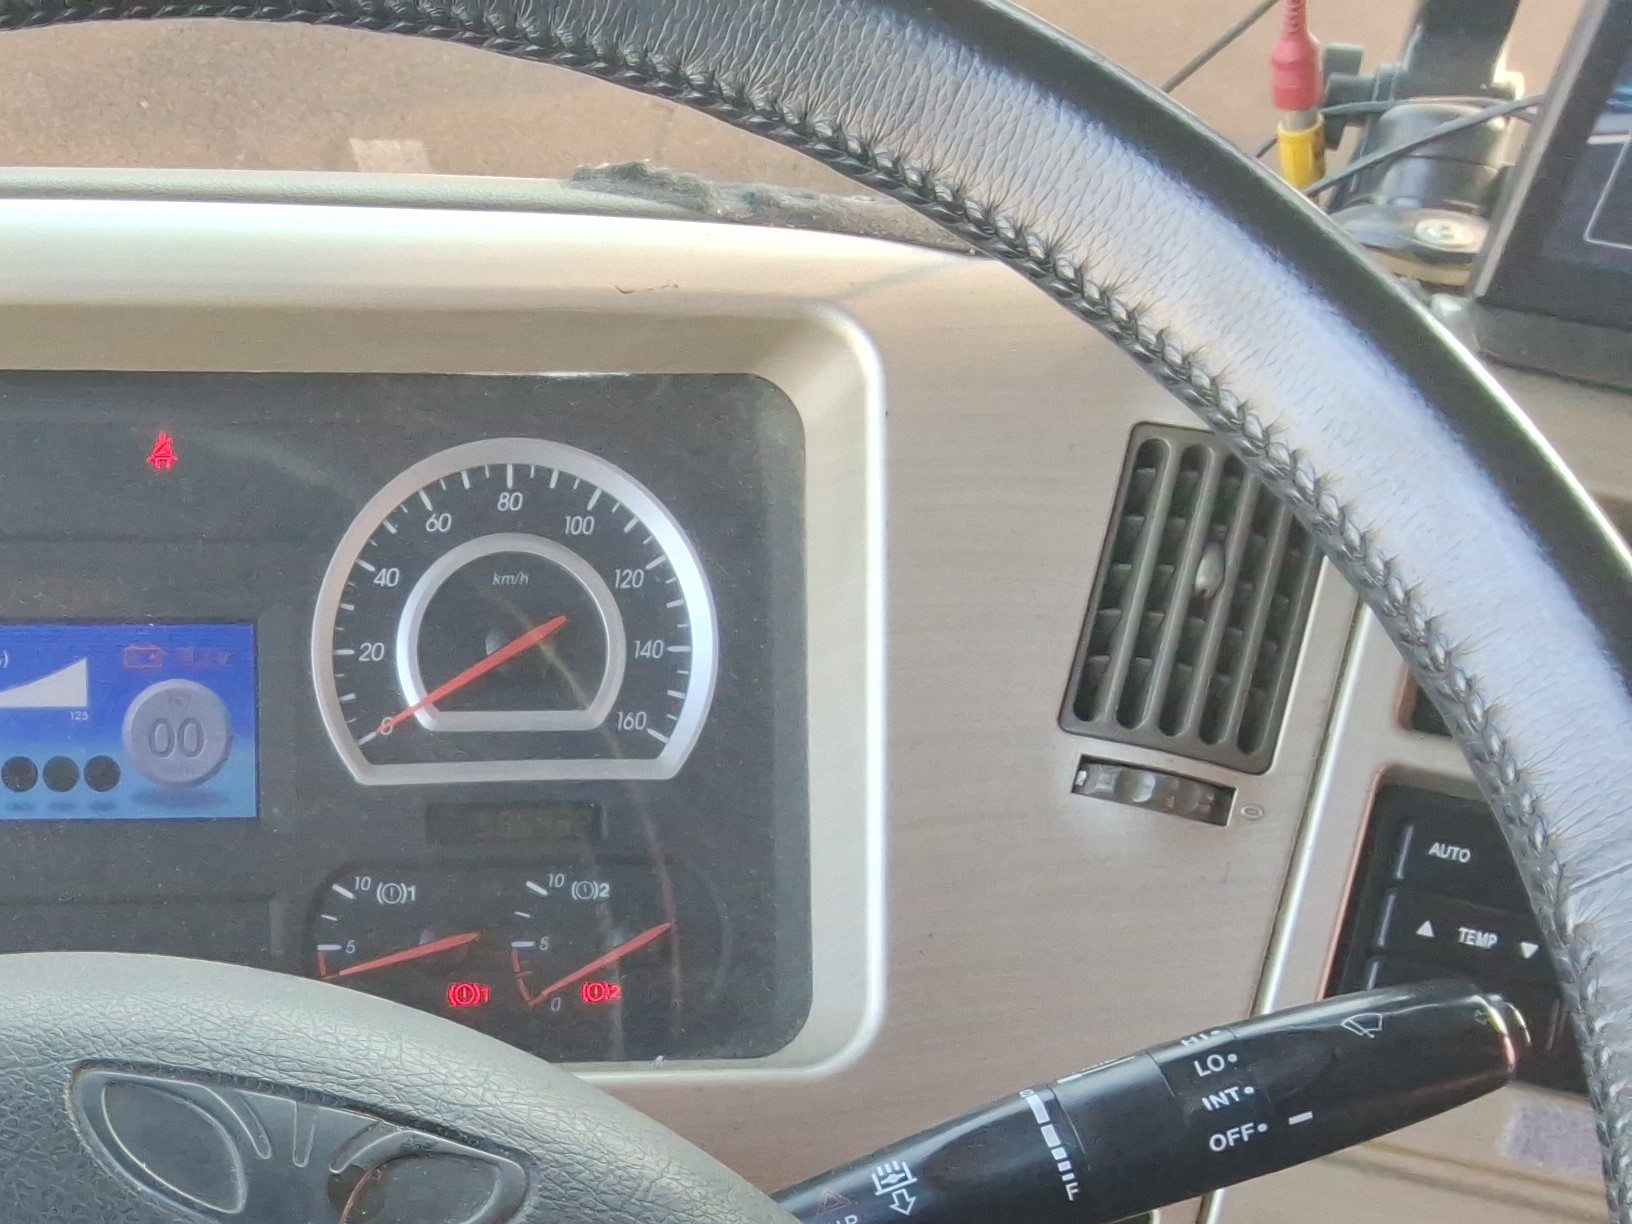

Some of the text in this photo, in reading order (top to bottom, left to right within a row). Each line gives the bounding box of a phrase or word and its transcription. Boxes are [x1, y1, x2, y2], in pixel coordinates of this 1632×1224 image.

[497, 492, 523, 512] 80
[425, 513, 452, 533] 60
[564, 515, 595, 536] 100
[374, 567, 400, 588] 40
[492, 571, 529, 587] km/h
[614, 568, 645, 589] 120
[358, 642, 385, 662] 20
[633, 639, 665, 659] 140
[379, 716, 394, 736] 0
[616, 711, 647, 731] 160
[149, 717, 205, 759] 00
[1428, 842, 1471, 864] AUTO
[354, 876, 372, 892] 10
[547, 873, 565, 889] 10
[598, 883, 610, 898] 2
[407, 886, 416, 902] 1
[345, 939, 356, 955] 5
[539, 935, 550, 952] 5
[1457, 926, 1499, 949] TEMP
[609, 984, 622, 1001] 2
[550, 996, 562, 1012] 0
[1193, 1053, 1225, 1077] LO
[1201, 1086, 1243, 1112] INT
[1209, 1121, 1255, 1152] OFF
[1065, 1181, 1081, 1202] F
